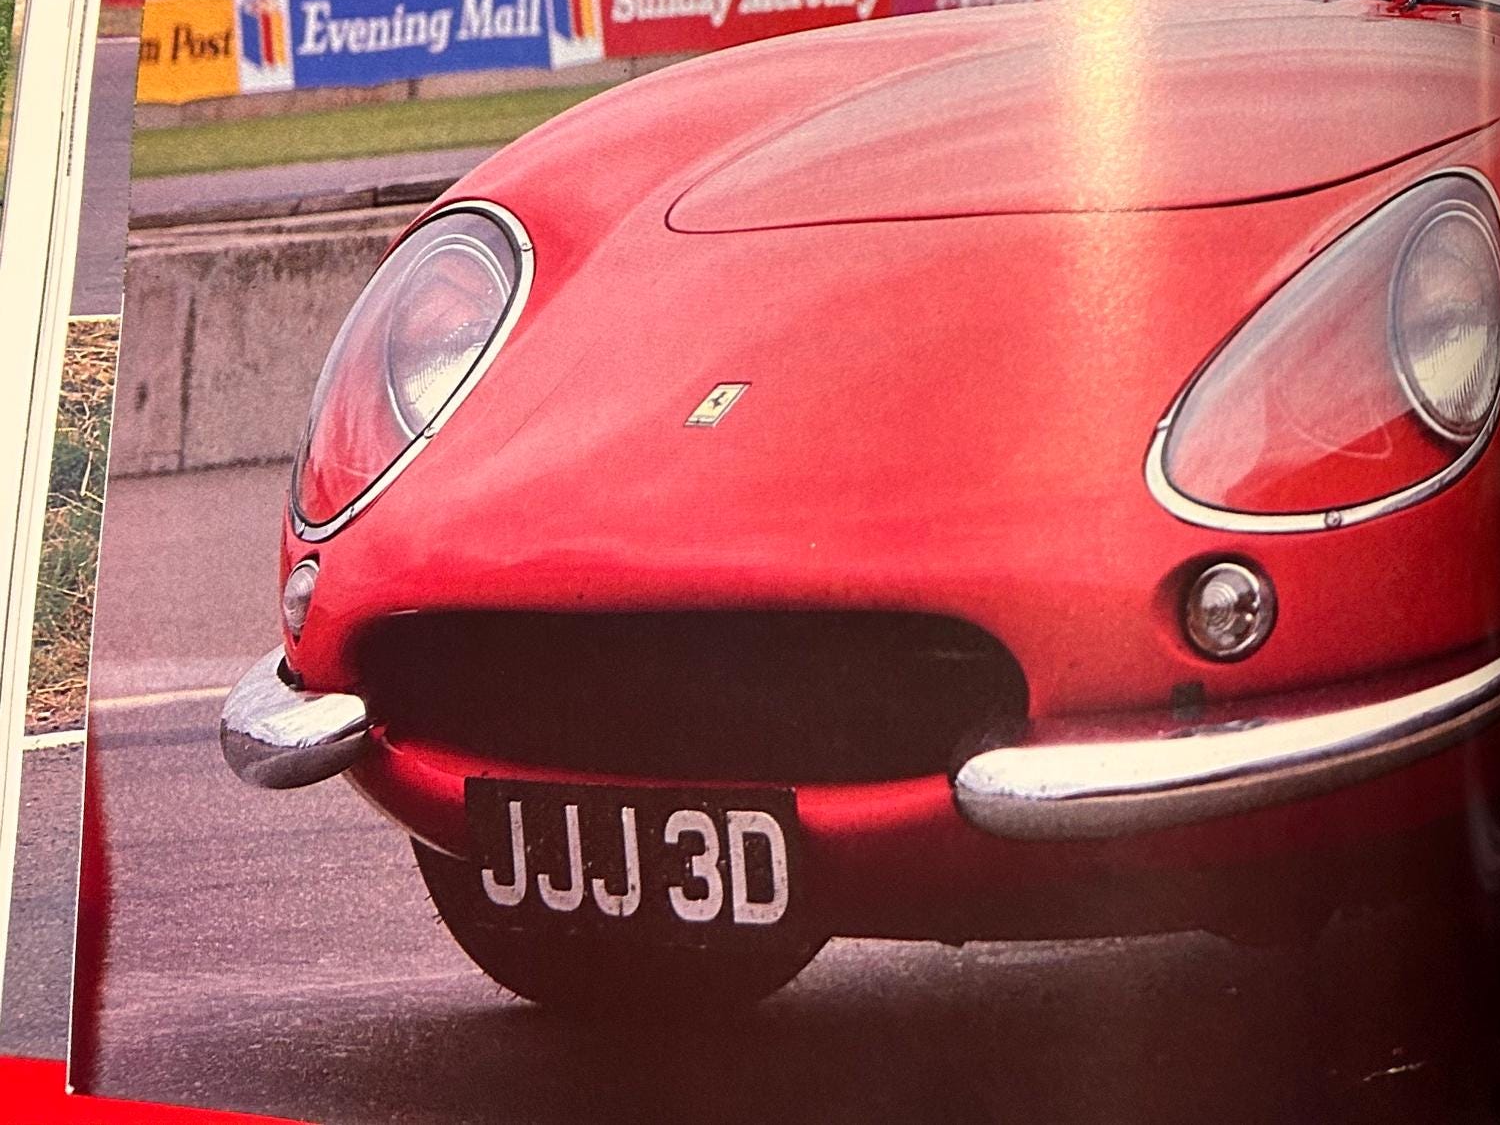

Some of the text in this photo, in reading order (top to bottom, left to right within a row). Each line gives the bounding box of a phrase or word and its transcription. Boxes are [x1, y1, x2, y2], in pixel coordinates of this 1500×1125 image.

[171, 22, 235, 66] Post
[481, 800, 790, 925] JJJ 3D
